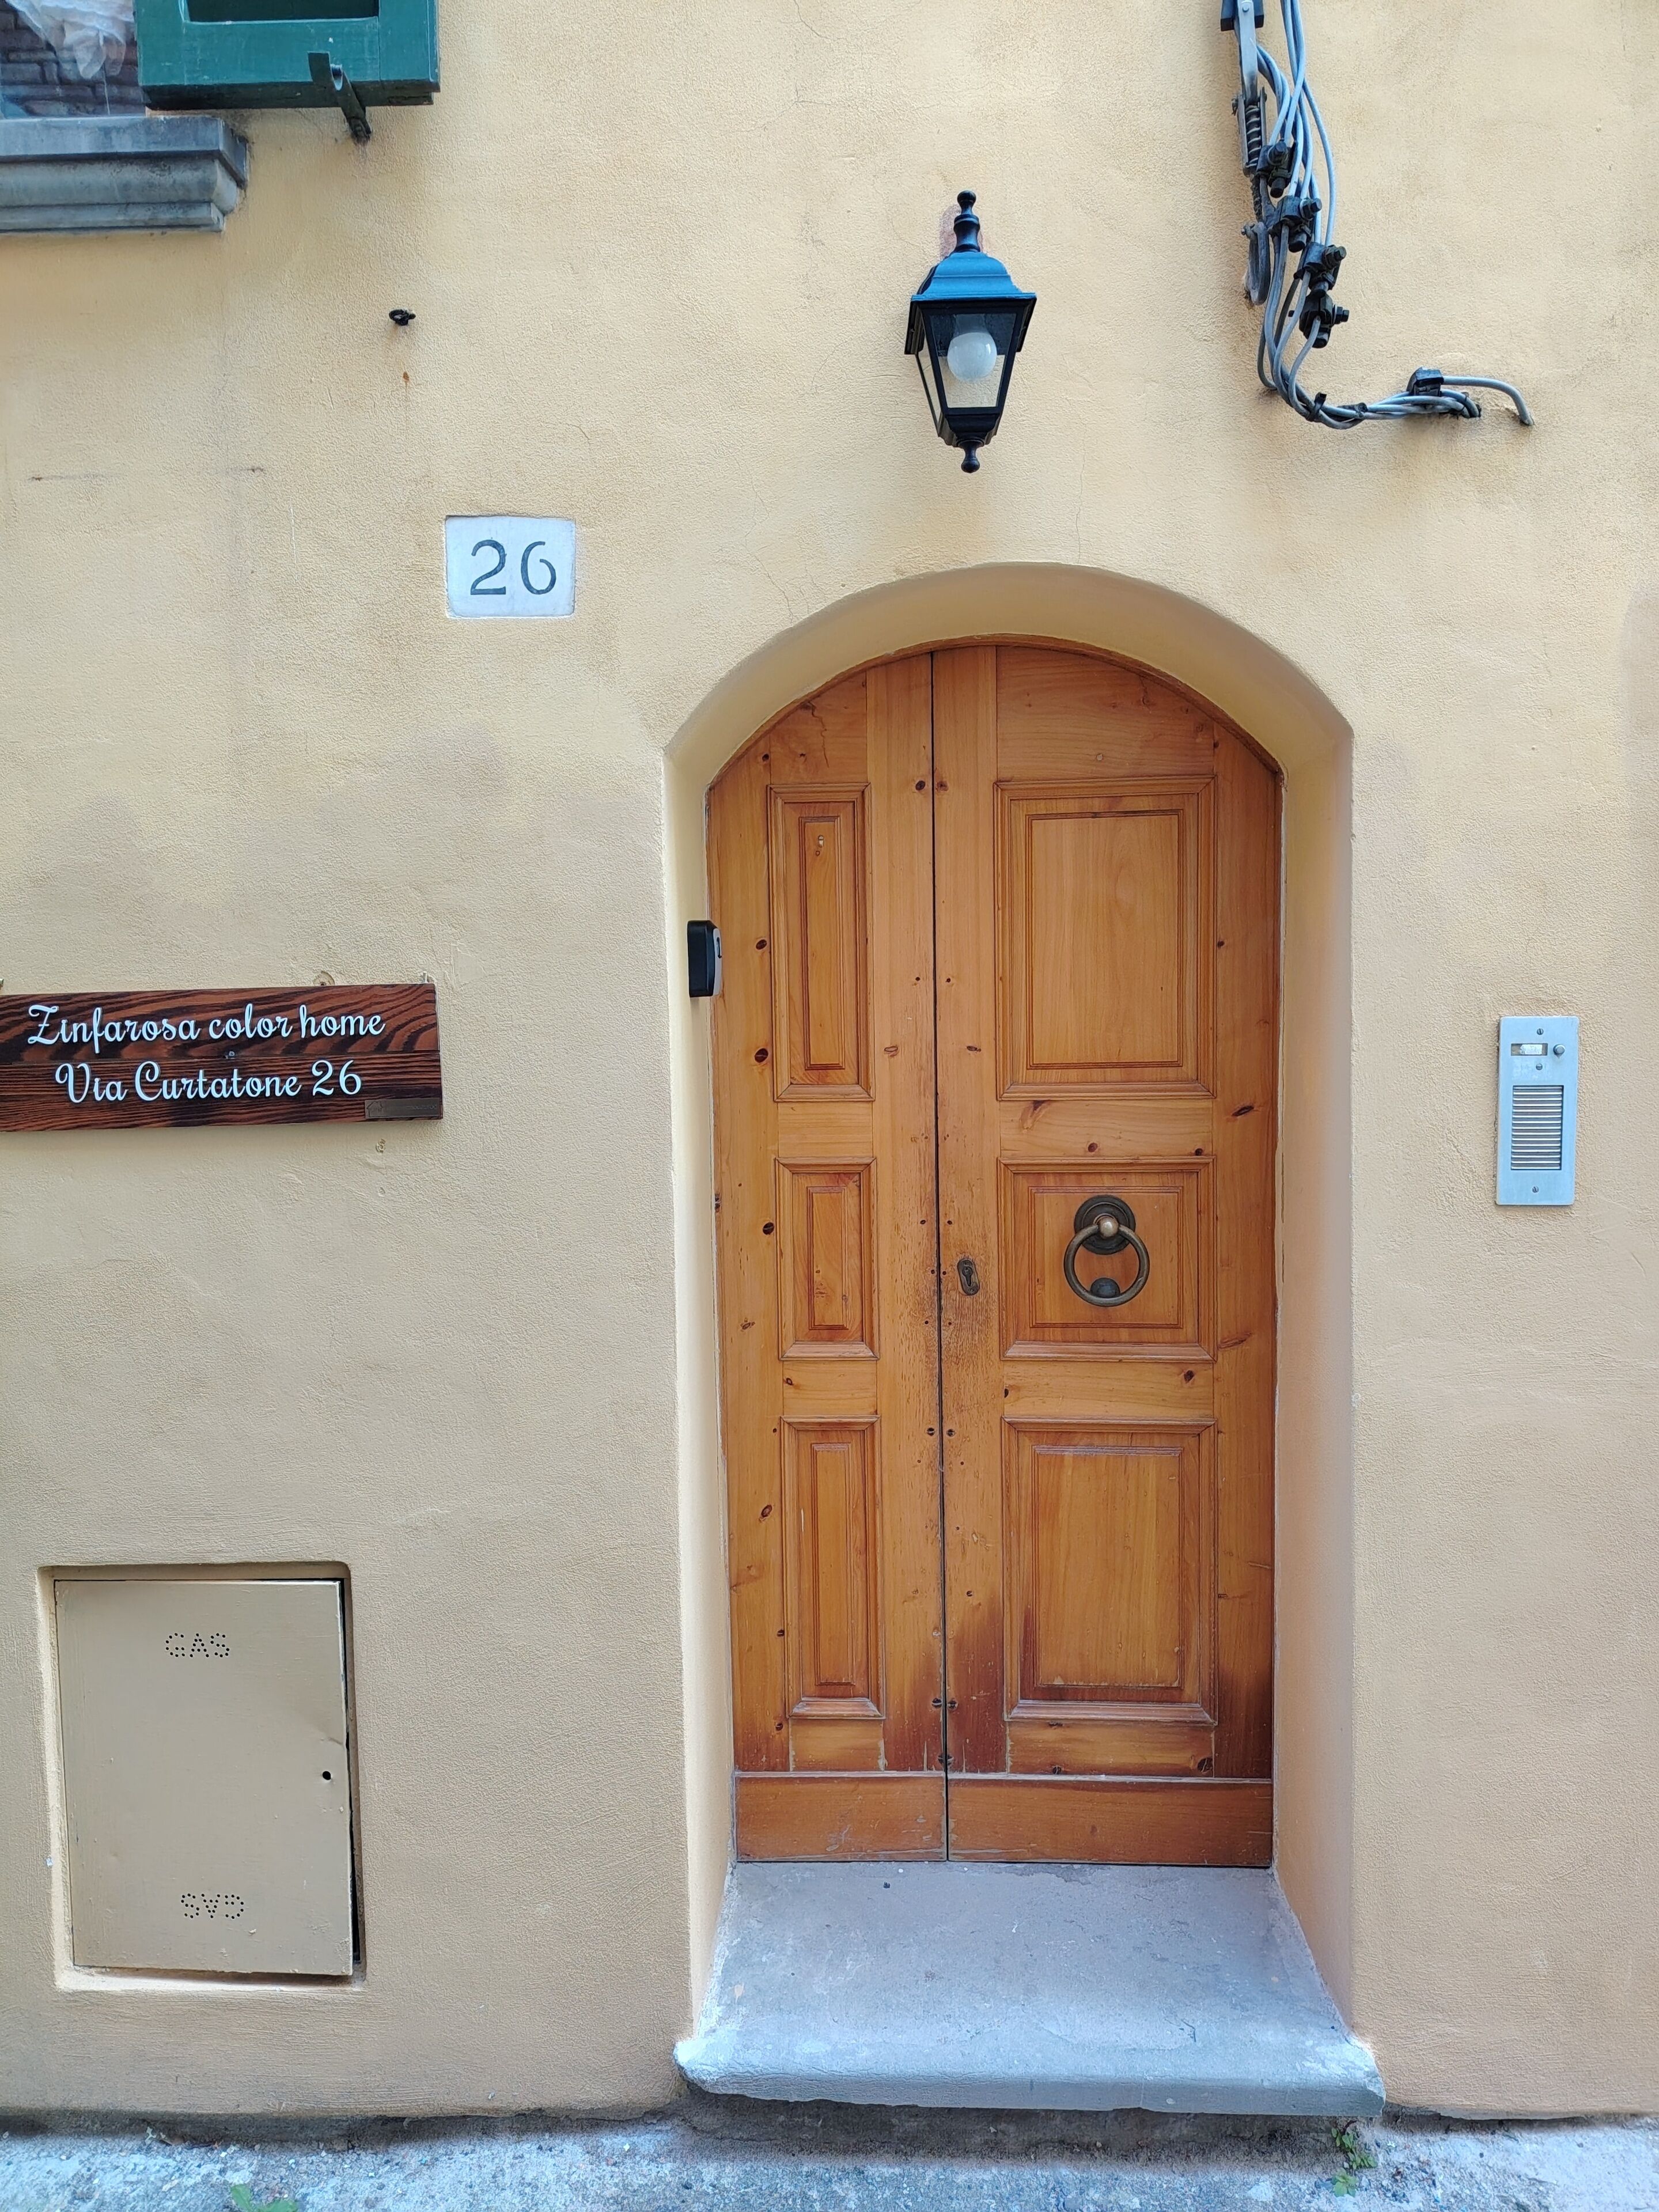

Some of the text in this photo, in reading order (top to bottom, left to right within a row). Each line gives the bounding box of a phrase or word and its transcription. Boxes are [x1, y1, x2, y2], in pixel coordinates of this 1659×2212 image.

[470, 539, 556, 595] 26
[27, 1002, 387, 1054] Zinfarosa color home
[55, 1059, 362, 1104] Via Curtatone 26
[165, 1633, 230, 1658] GAS
